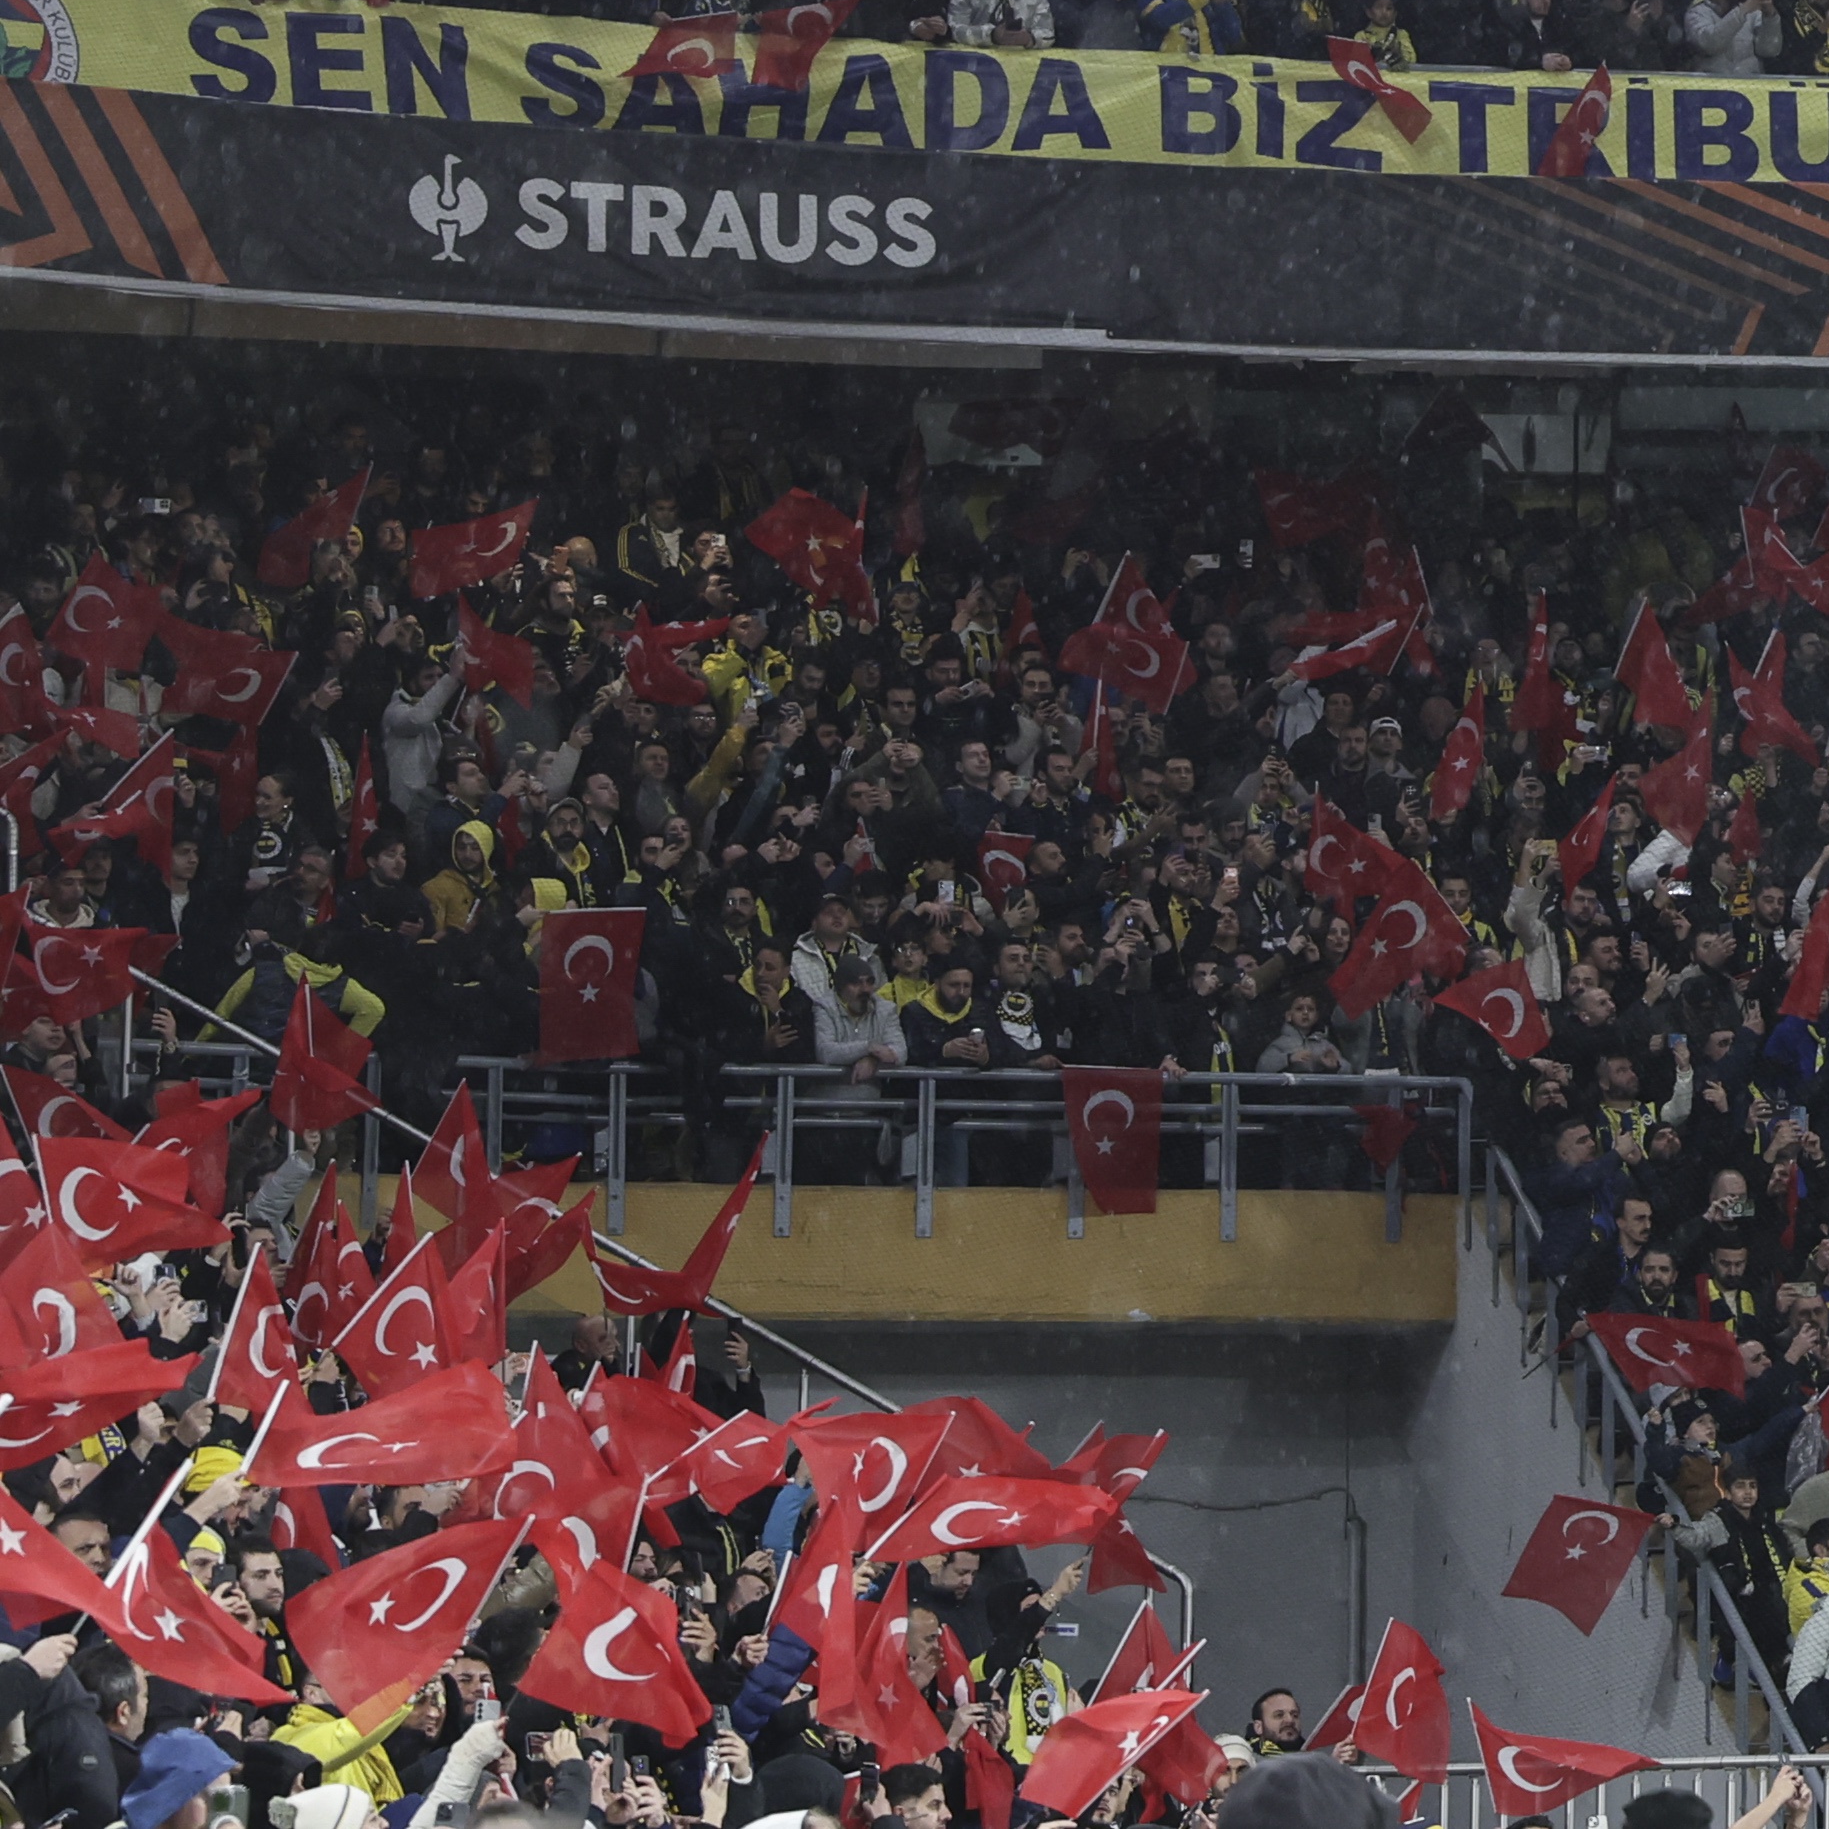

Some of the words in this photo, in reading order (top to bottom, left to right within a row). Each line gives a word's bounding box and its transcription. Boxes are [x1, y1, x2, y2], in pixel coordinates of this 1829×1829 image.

[189, 6, 472, 122] SEN
[521, 41, 1112, 151] SAHADA
[513, 176, 940, 269] STRAUSS
